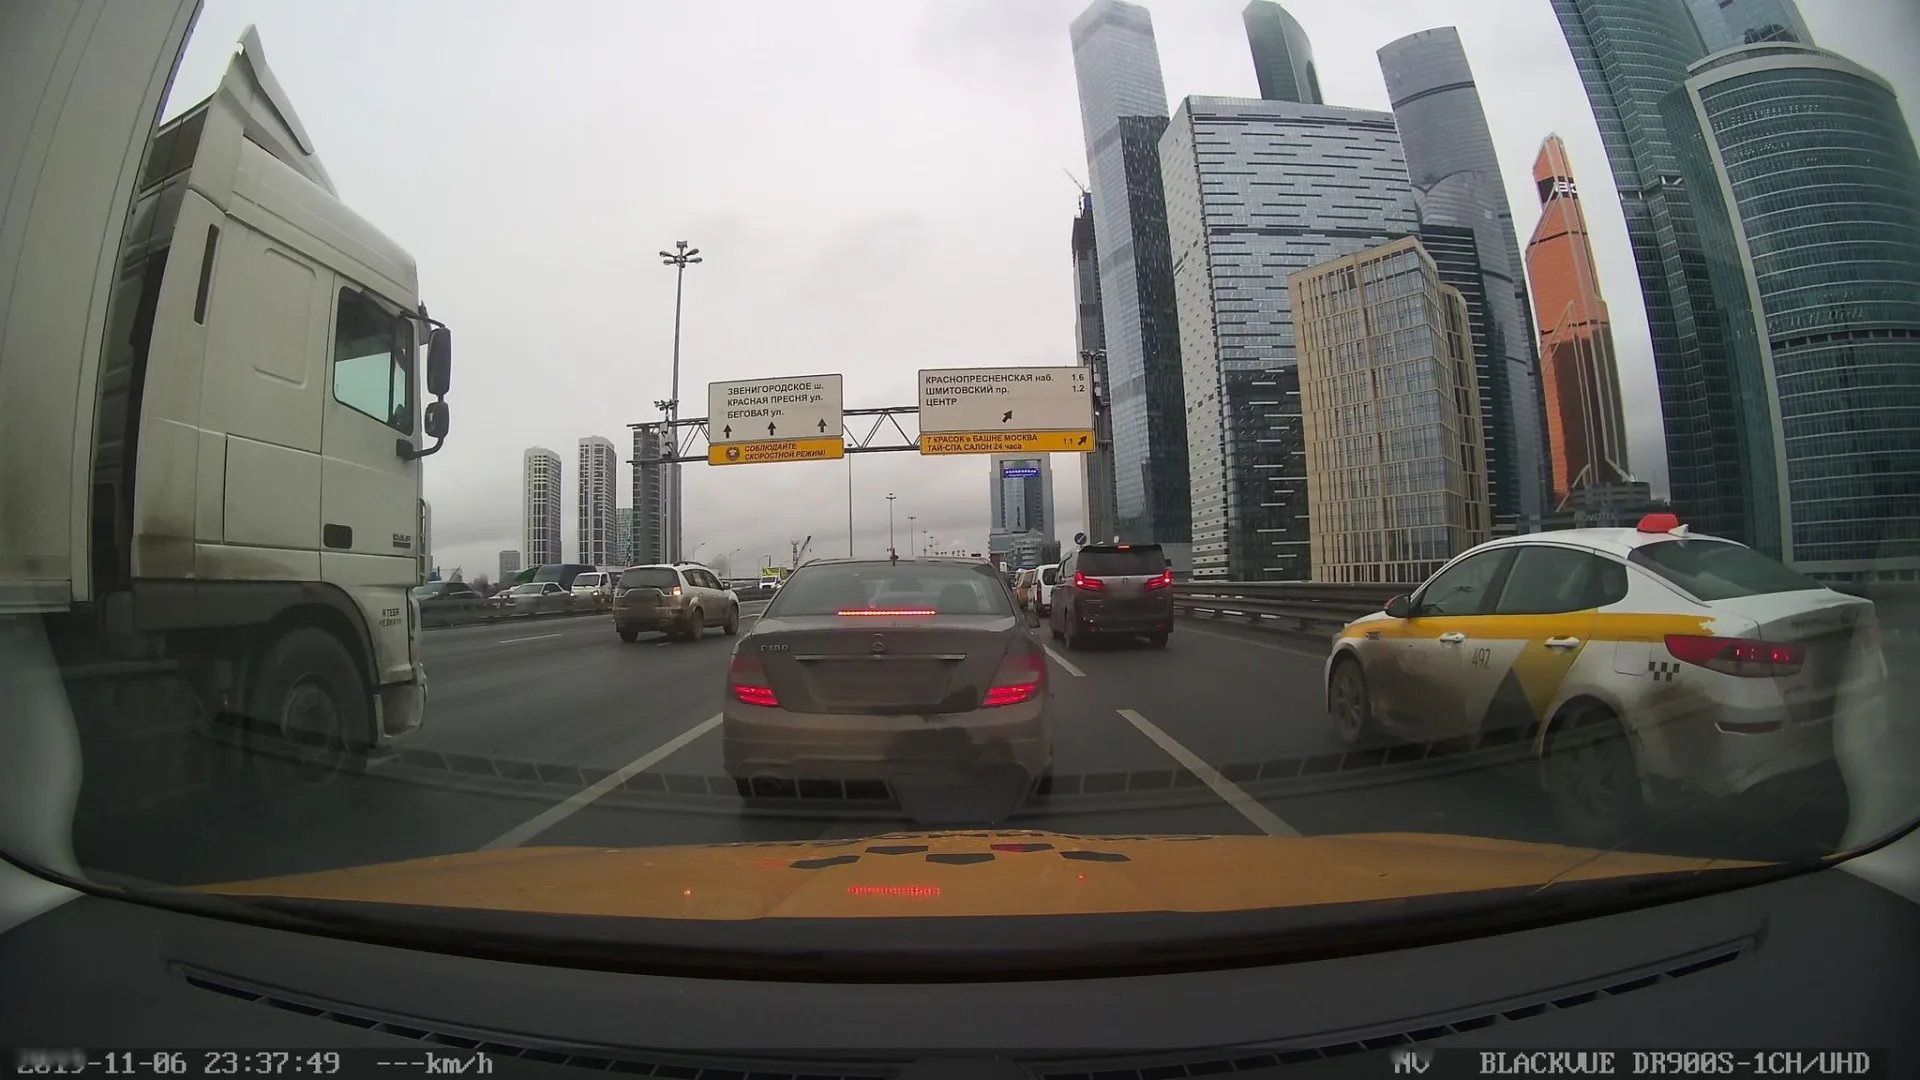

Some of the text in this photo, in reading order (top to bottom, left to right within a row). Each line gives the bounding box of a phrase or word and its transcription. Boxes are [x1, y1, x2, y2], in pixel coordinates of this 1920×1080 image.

[925, 374, 1033, 384] КРАСНОПРЕСНЕНСКАЯ
[1035, 374, 1054, 382] наб.
[727, 383, 812, 395] ЗВЕНИГОРОДСКОЕ
[925, 385, 994, 395] ШМИТОВСКИЙ
[995, 387, 1010, 395] пр.
[727, 394, 824, 407] КРАСНАЯ ПРЕСНЯ ул.
[926, 398, 958, 407] ЦЕНТР
[727, 409, 784, 419] БЕГОВАЯ ул.
[1004, 434, 1038, 442] МОСКВА
[964, 443, 992, 451] САЛОН
[796, 449, 826, 458] РЕЖИМ!
[1471, 648, 1491, 669] 492
